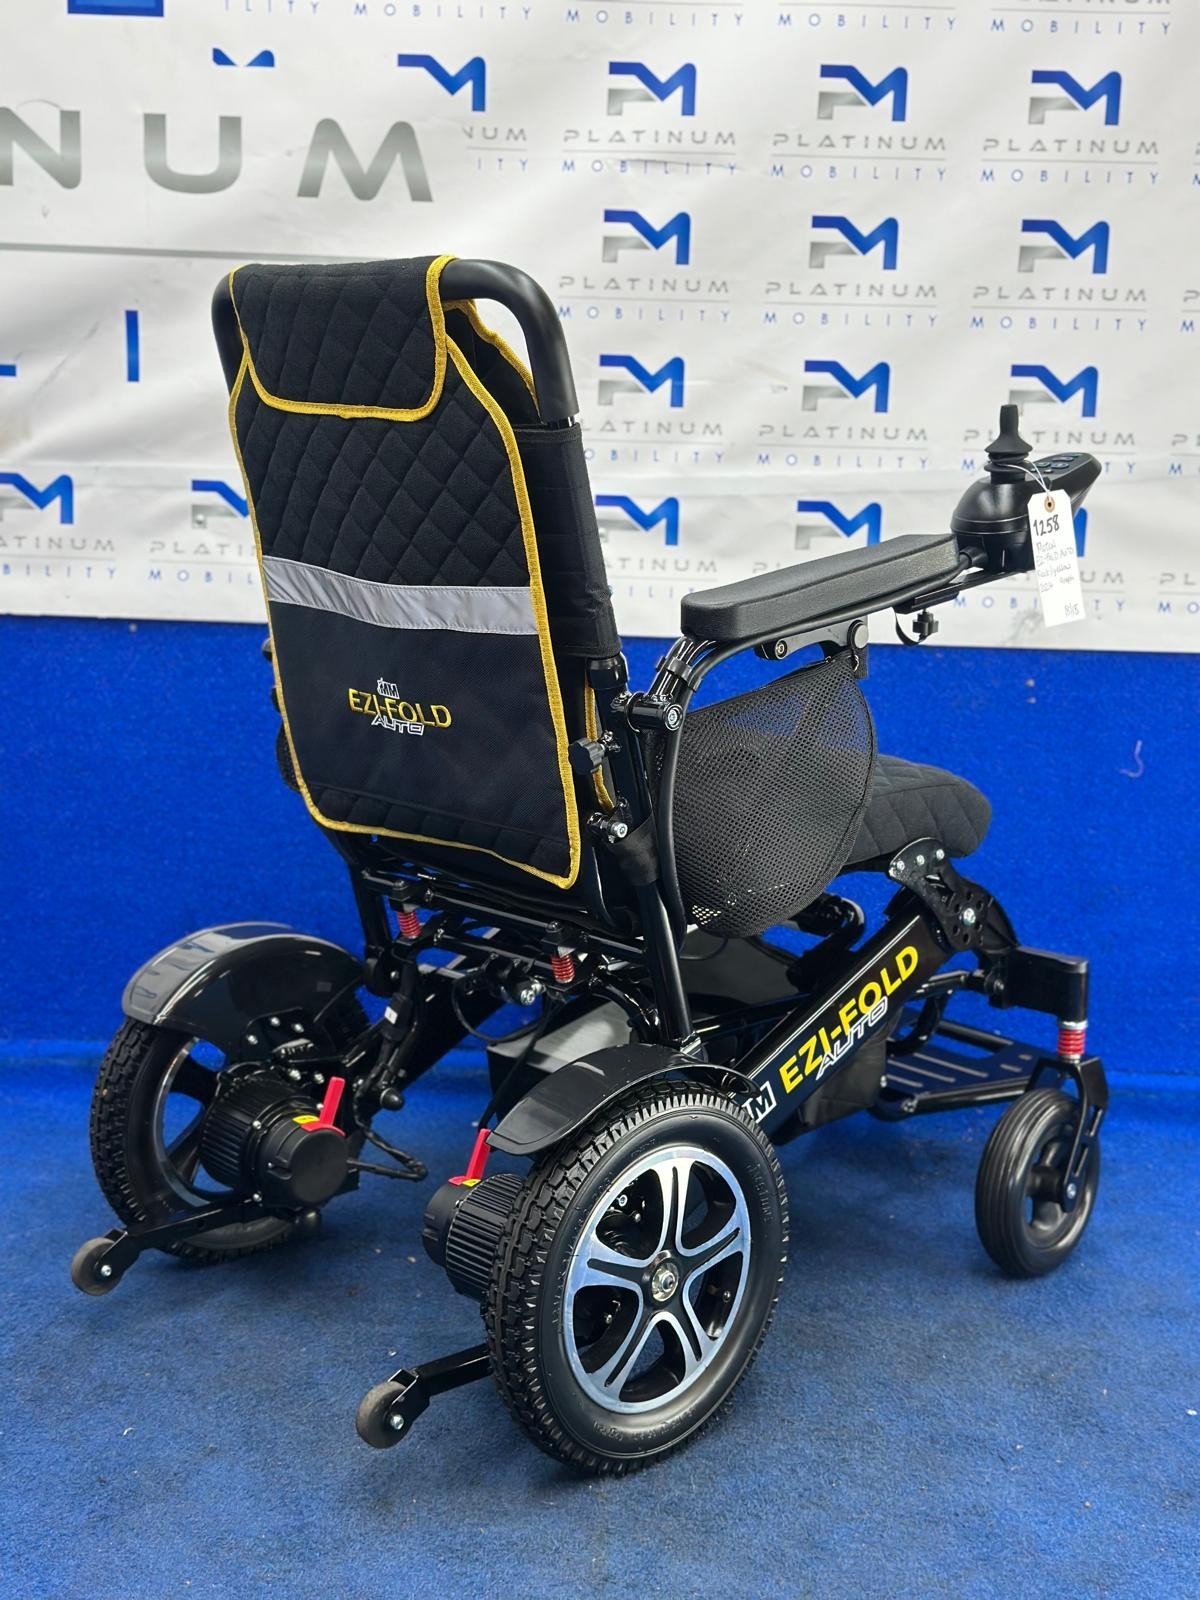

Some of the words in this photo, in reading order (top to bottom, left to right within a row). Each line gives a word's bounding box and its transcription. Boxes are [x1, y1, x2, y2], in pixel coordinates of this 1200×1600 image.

[354, 3, 531, 20] MOBILITY
[566, 9, 743, 27] MOBILITY
[778, 13, 956, 31] MOBILITY
[991, 19, 1170, 35] MOBILITY
[563, 129, 737, 146] PLATINUM
[772, 133, 946, 151] PLATINUM
[982, 138, 1159, 155] PLATINUM
[562, 160, 736, 175] MOBILITY
[770, 165, 946, 182] MOBILITY
[980, 169, 1159, 185] MOBILITY
[559, 276, 729, 294] PLATINUM
[765, 281, 937, 298] PLATINUM
[973, 286, 1147, 302] PLATINUM
[558, 306, 730, 323] MOBILITY
[764, 312, 937, 328] MOBILITY
[970, 317, 1147, 332] MOBILITY
[758, 424, 928, 441] PLATINUM
[757, 454, 929, 470] MOBILITY
[1033, 514, 1060, 536] 1258
[348, 687, 452, 729] EZI-FOLD
[371, 715, 425, 736] AUTO
[778, 945, 919, 1094] EZI-FOLD
[815, 995, 888, 1081] AUTO
